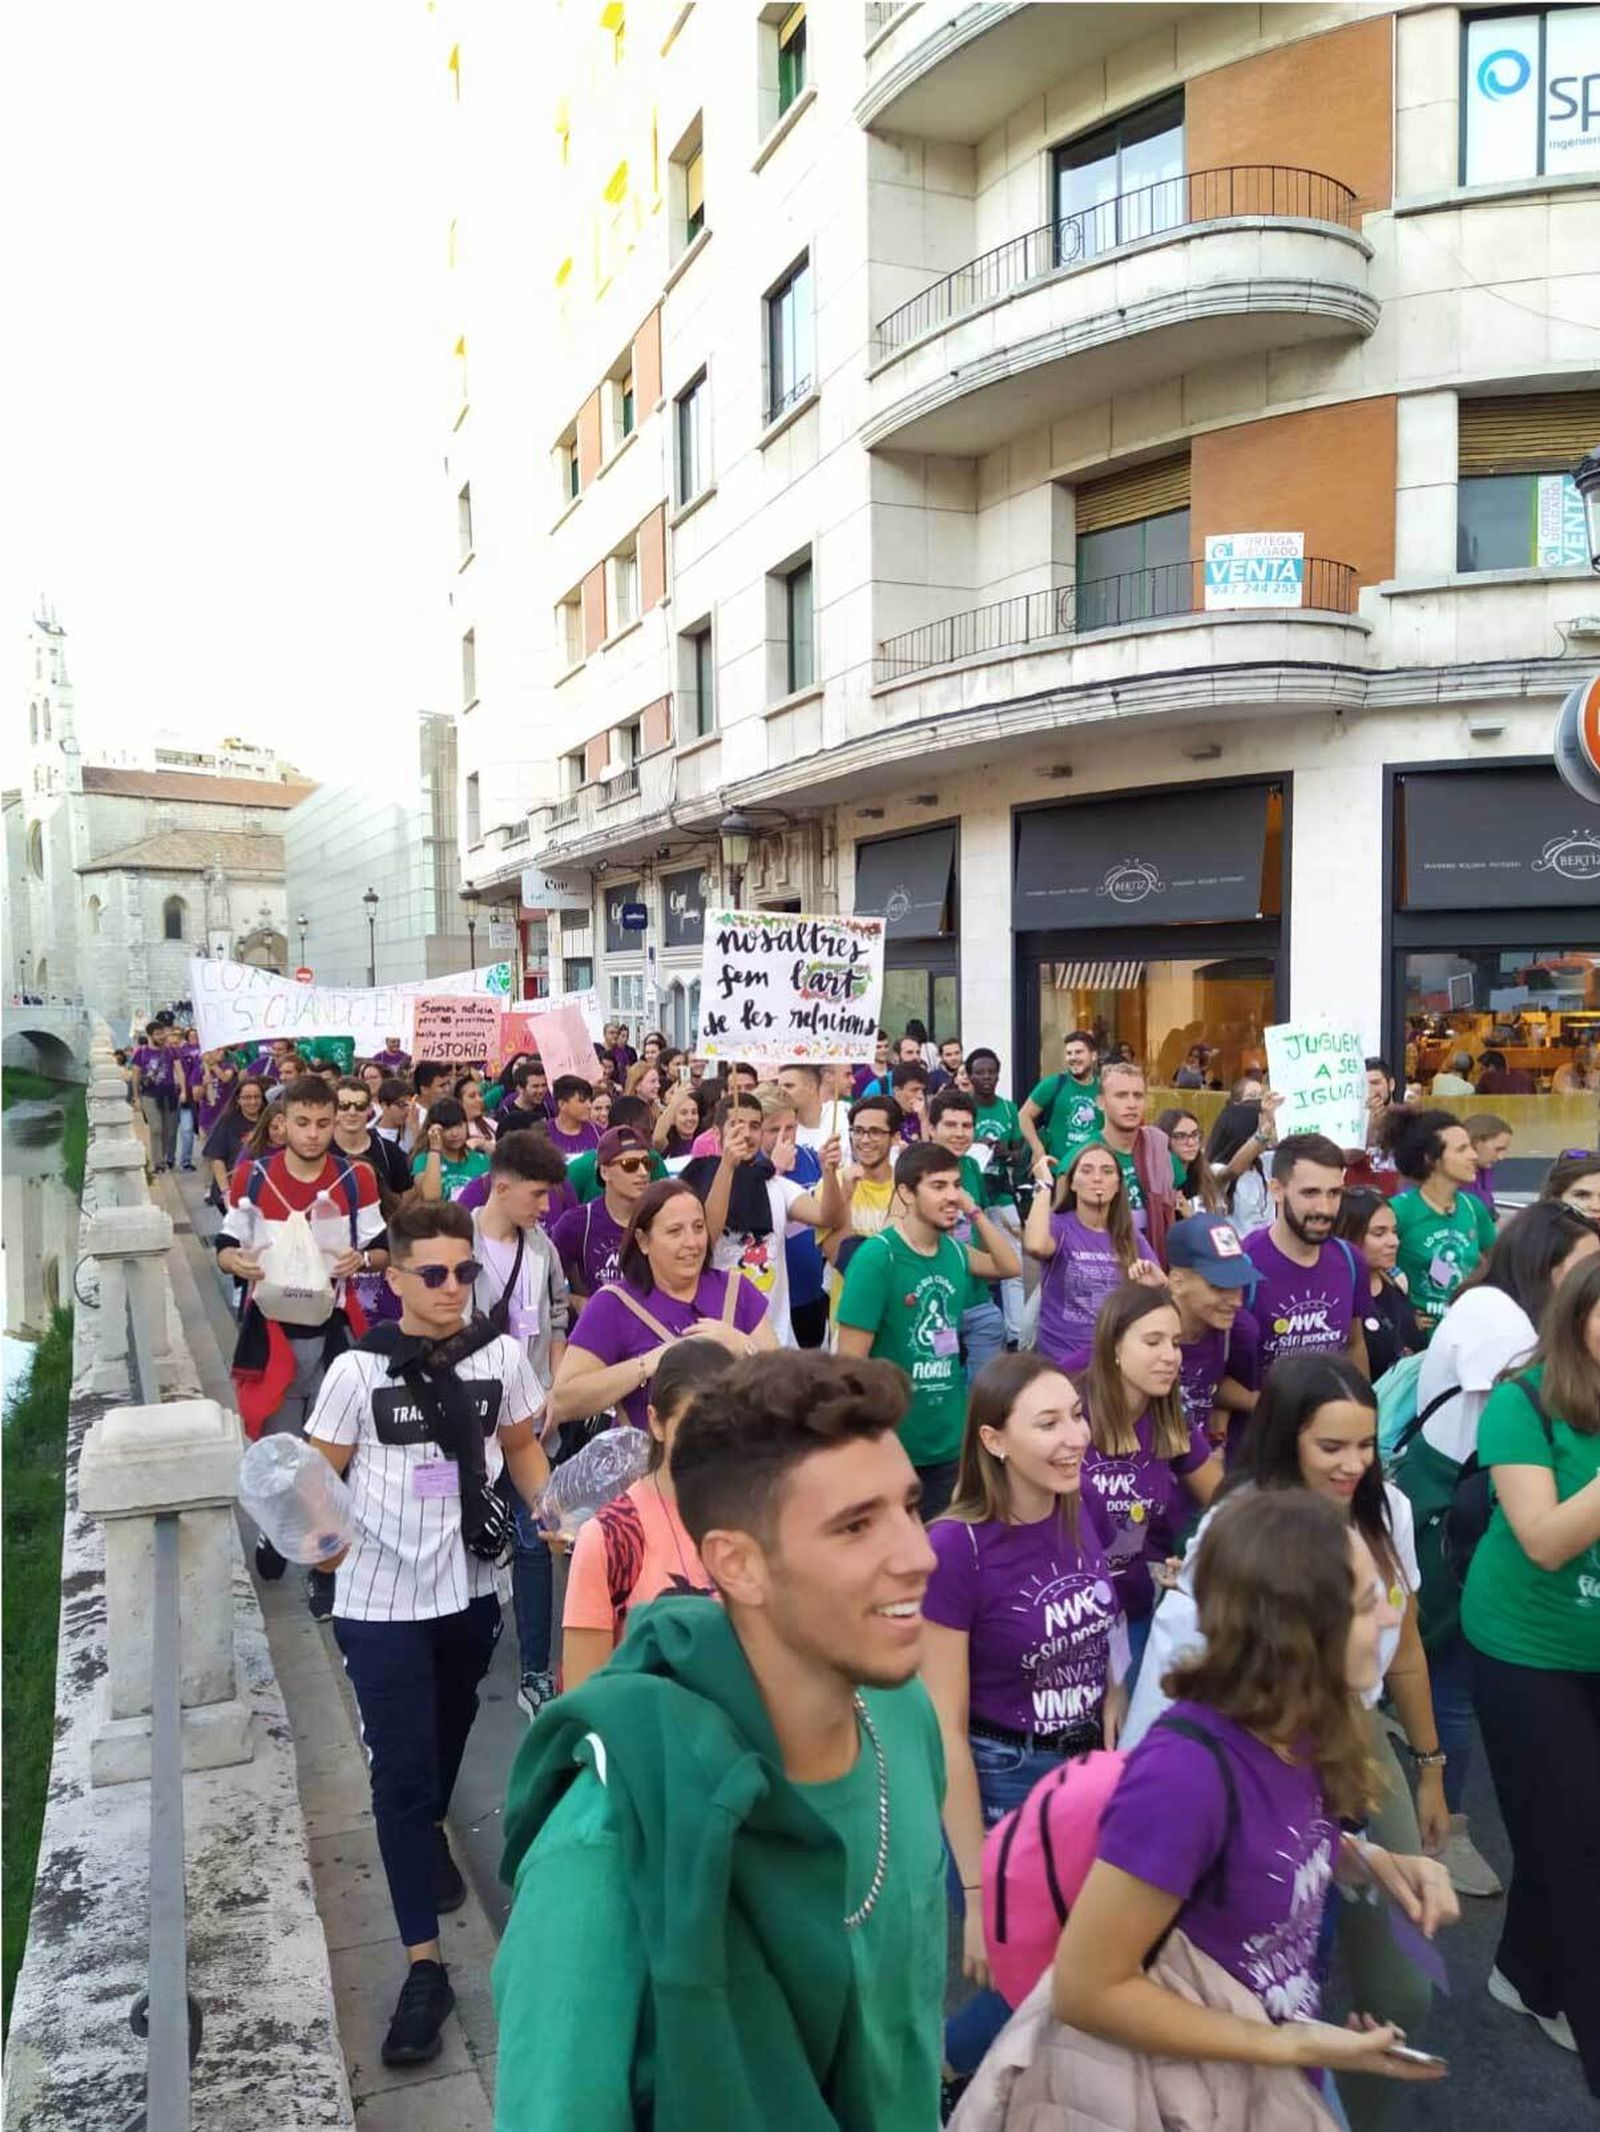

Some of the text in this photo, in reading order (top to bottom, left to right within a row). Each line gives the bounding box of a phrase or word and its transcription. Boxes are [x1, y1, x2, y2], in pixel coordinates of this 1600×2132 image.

[1209, 558, 1299, 583] VENTA
[716, 922, 869, 963] nosaltres
[716, 964, 769, 999] fem
[421, 1001, 457, 1015] Somos
[703, 1011, 730, 1037] de
[740, 999, 778, 1030] les
[1314, 1063, 1332, 1079] A
